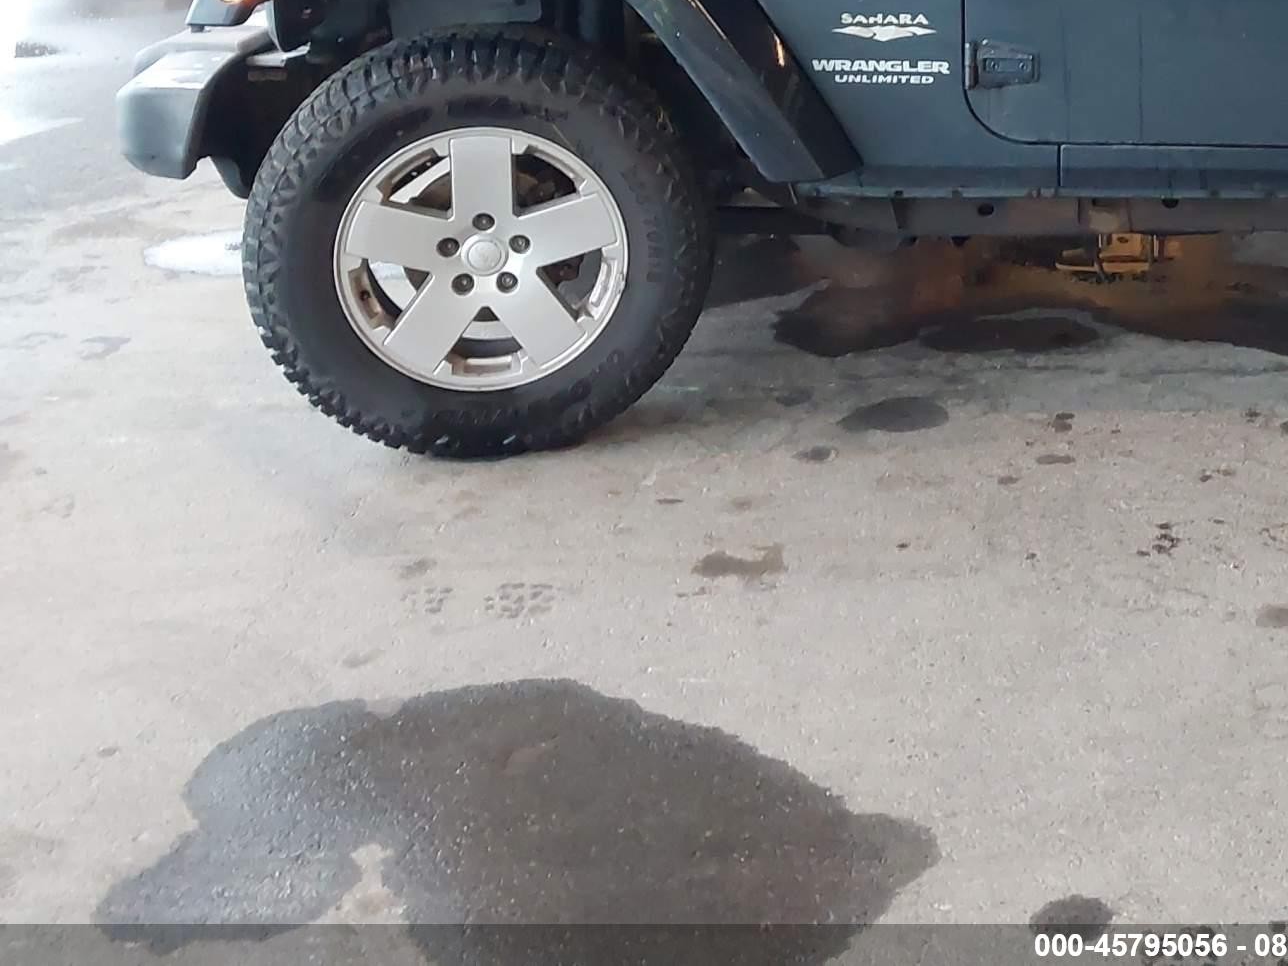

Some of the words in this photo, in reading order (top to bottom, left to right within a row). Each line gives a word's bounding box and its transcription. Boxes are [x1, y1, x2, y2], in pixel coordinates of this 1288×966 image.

[841, 13, 929, 25] SAHARA
[811, 59, 950, 75] WRANGLER
[834, 74, 935, 85] UNLIMITED
